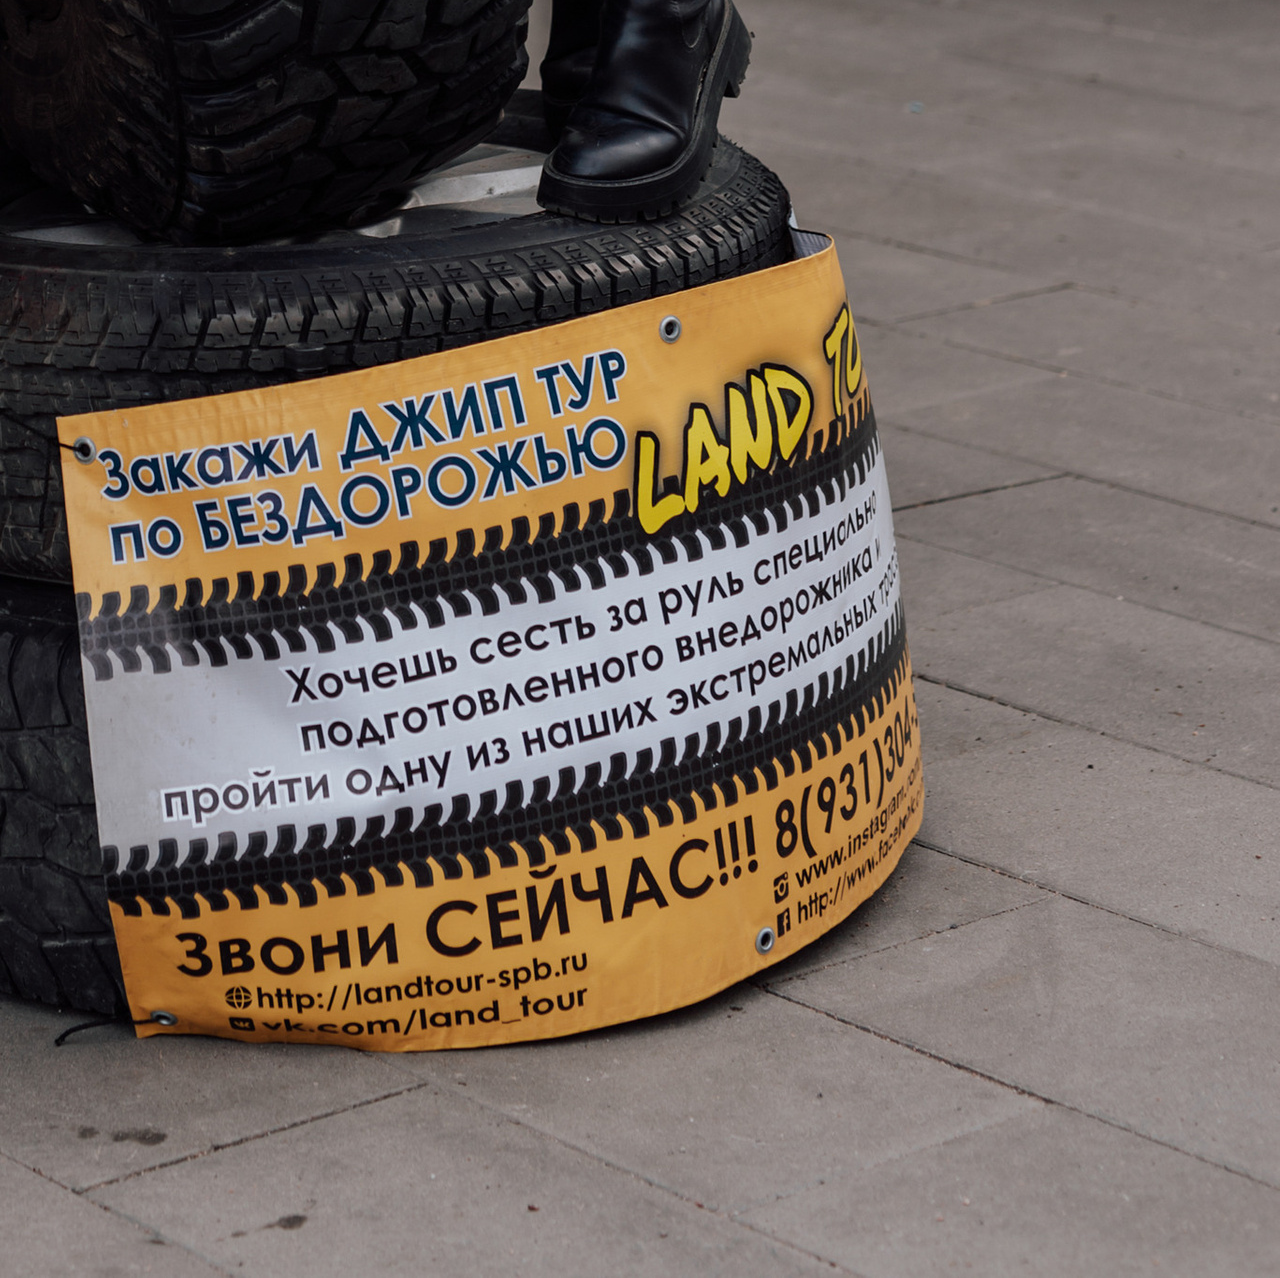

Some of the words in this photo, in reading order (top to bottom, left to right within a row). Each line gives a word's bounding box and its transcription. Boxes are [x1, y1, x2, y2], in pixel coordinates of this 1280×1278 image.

[98, 430, 320, 499] Закажи
[339, 373, 528, 471] ДЖИП
[534, 349, 628, 418] ТУР
[108, 516, 184, 565] по
[193, 415, 628, 553] БЕЗДОРОЖЬЮ
[633, 362, 815, 537] LAND
[284, 648, 458, 704] Хочешь
[469, 615, 596, 666] сесть
[607, 597, 648, 632] за
[658, 570, 744, 625] руль
[753, 490, 877, 586] специально
[300, 644, 664, 752] подготовленного
[675, 545, 873, 663] внедорожника
[162, 769, 331, 825] пройти
[345, 750, 452, 796] одну
[466, 737, 511, 772] из
[522, 697, 658, 758] наших
[666, 588, 878, 716] экстремальных
[425, 815, 759, 958] СЕЙЧАС!!!
[256, 952, 589, 1014] http://landtour-spb.ru
[262, 985, 588, 1036] vk.com/land_tour
